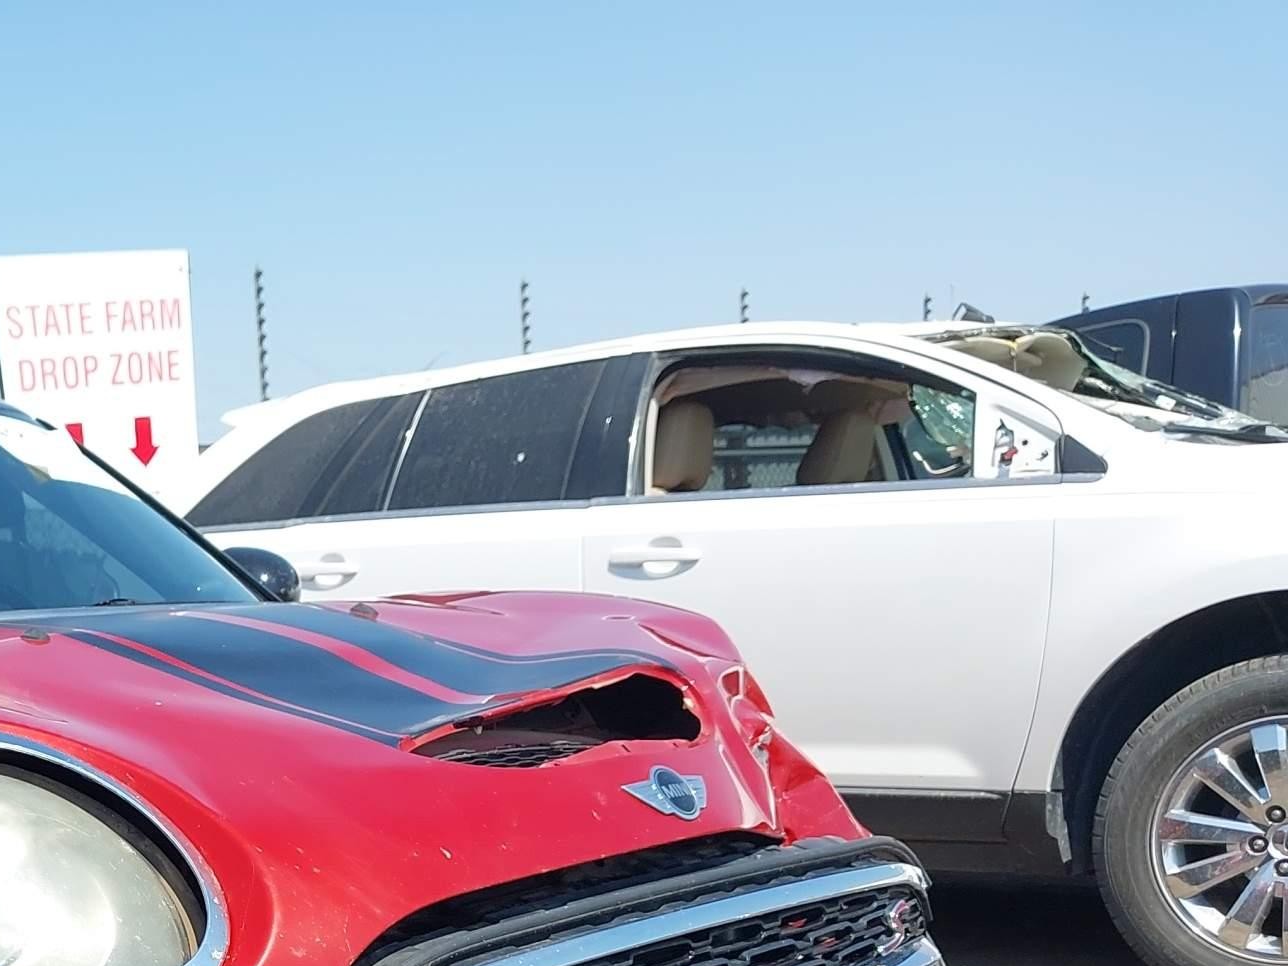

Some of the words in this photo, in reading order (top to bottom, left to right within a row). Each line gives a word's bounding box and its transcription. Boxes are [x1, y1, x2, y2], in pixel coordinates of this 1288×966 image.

[6, 302, 94, 340] STATE
[105, 298, 183, 333] FARM
[18, 355, 98, 393] DROP
[111, 350, 180, 385] ZONE
